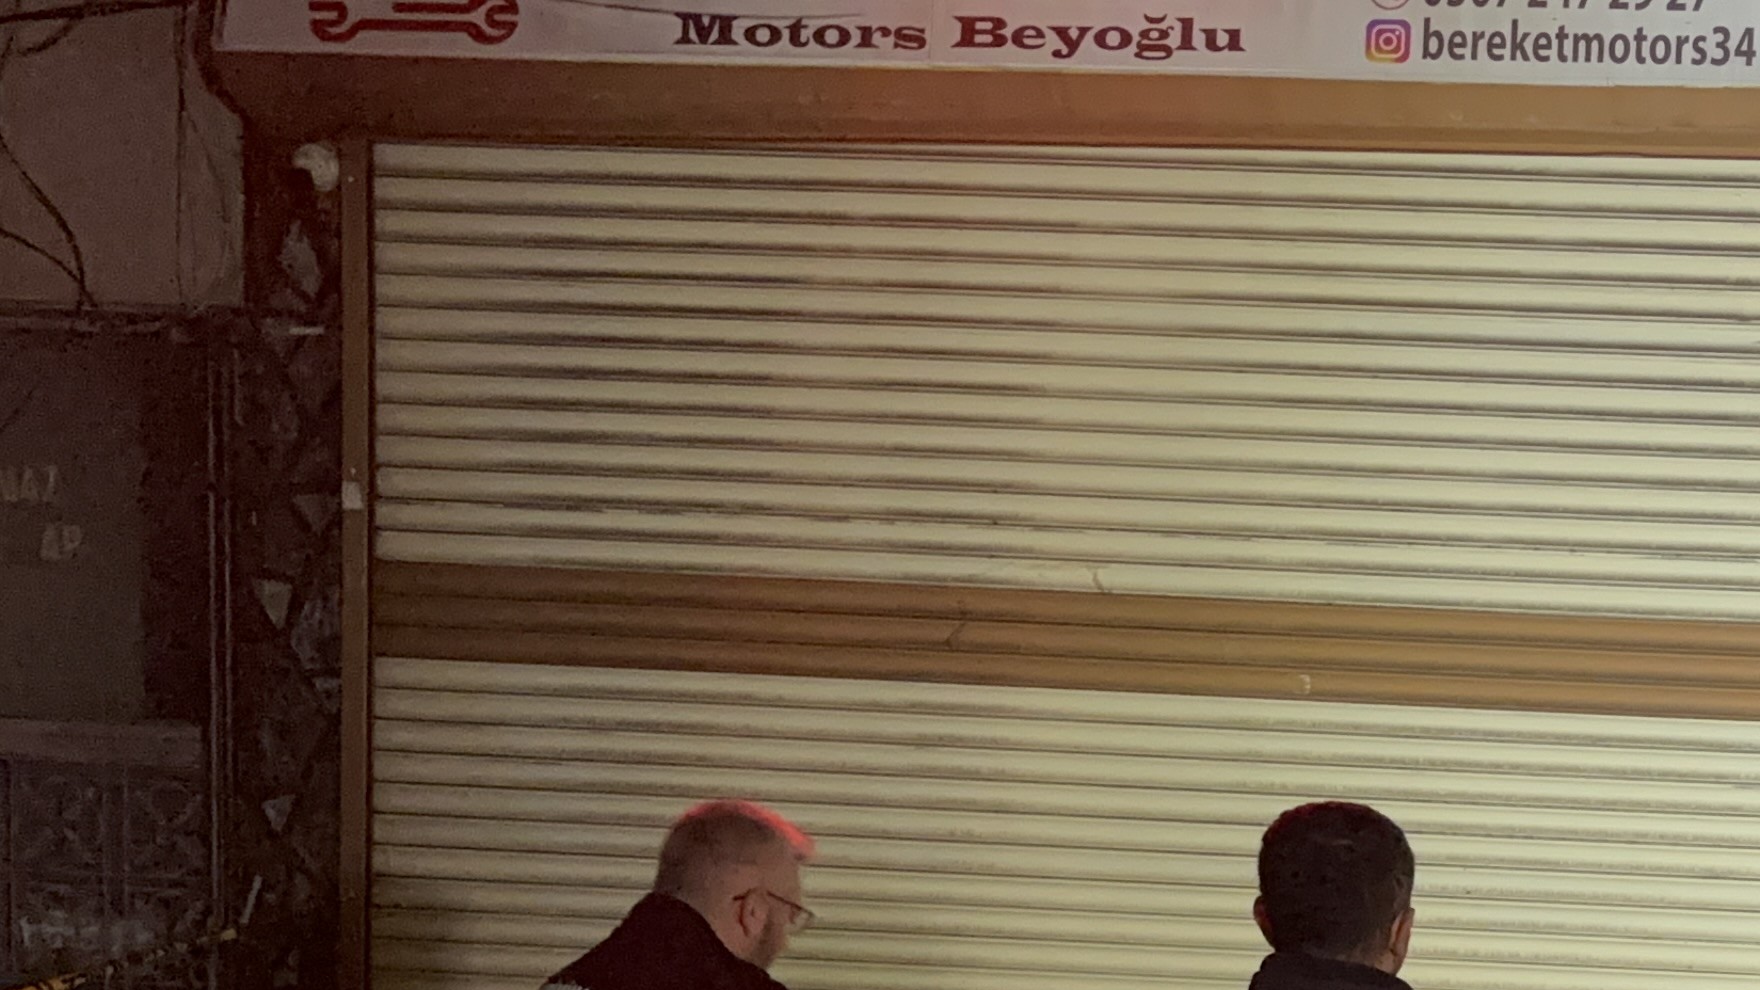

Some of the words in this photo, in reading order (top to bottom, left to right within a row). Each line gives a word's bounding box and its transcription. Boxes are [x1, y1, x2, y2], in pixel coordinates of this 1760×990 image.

[673, 12, 928, 50] Motors
[950, 13, 1247, 60] Beyoğlu
[1421, 17, 1757, 67] bereketmotors34
